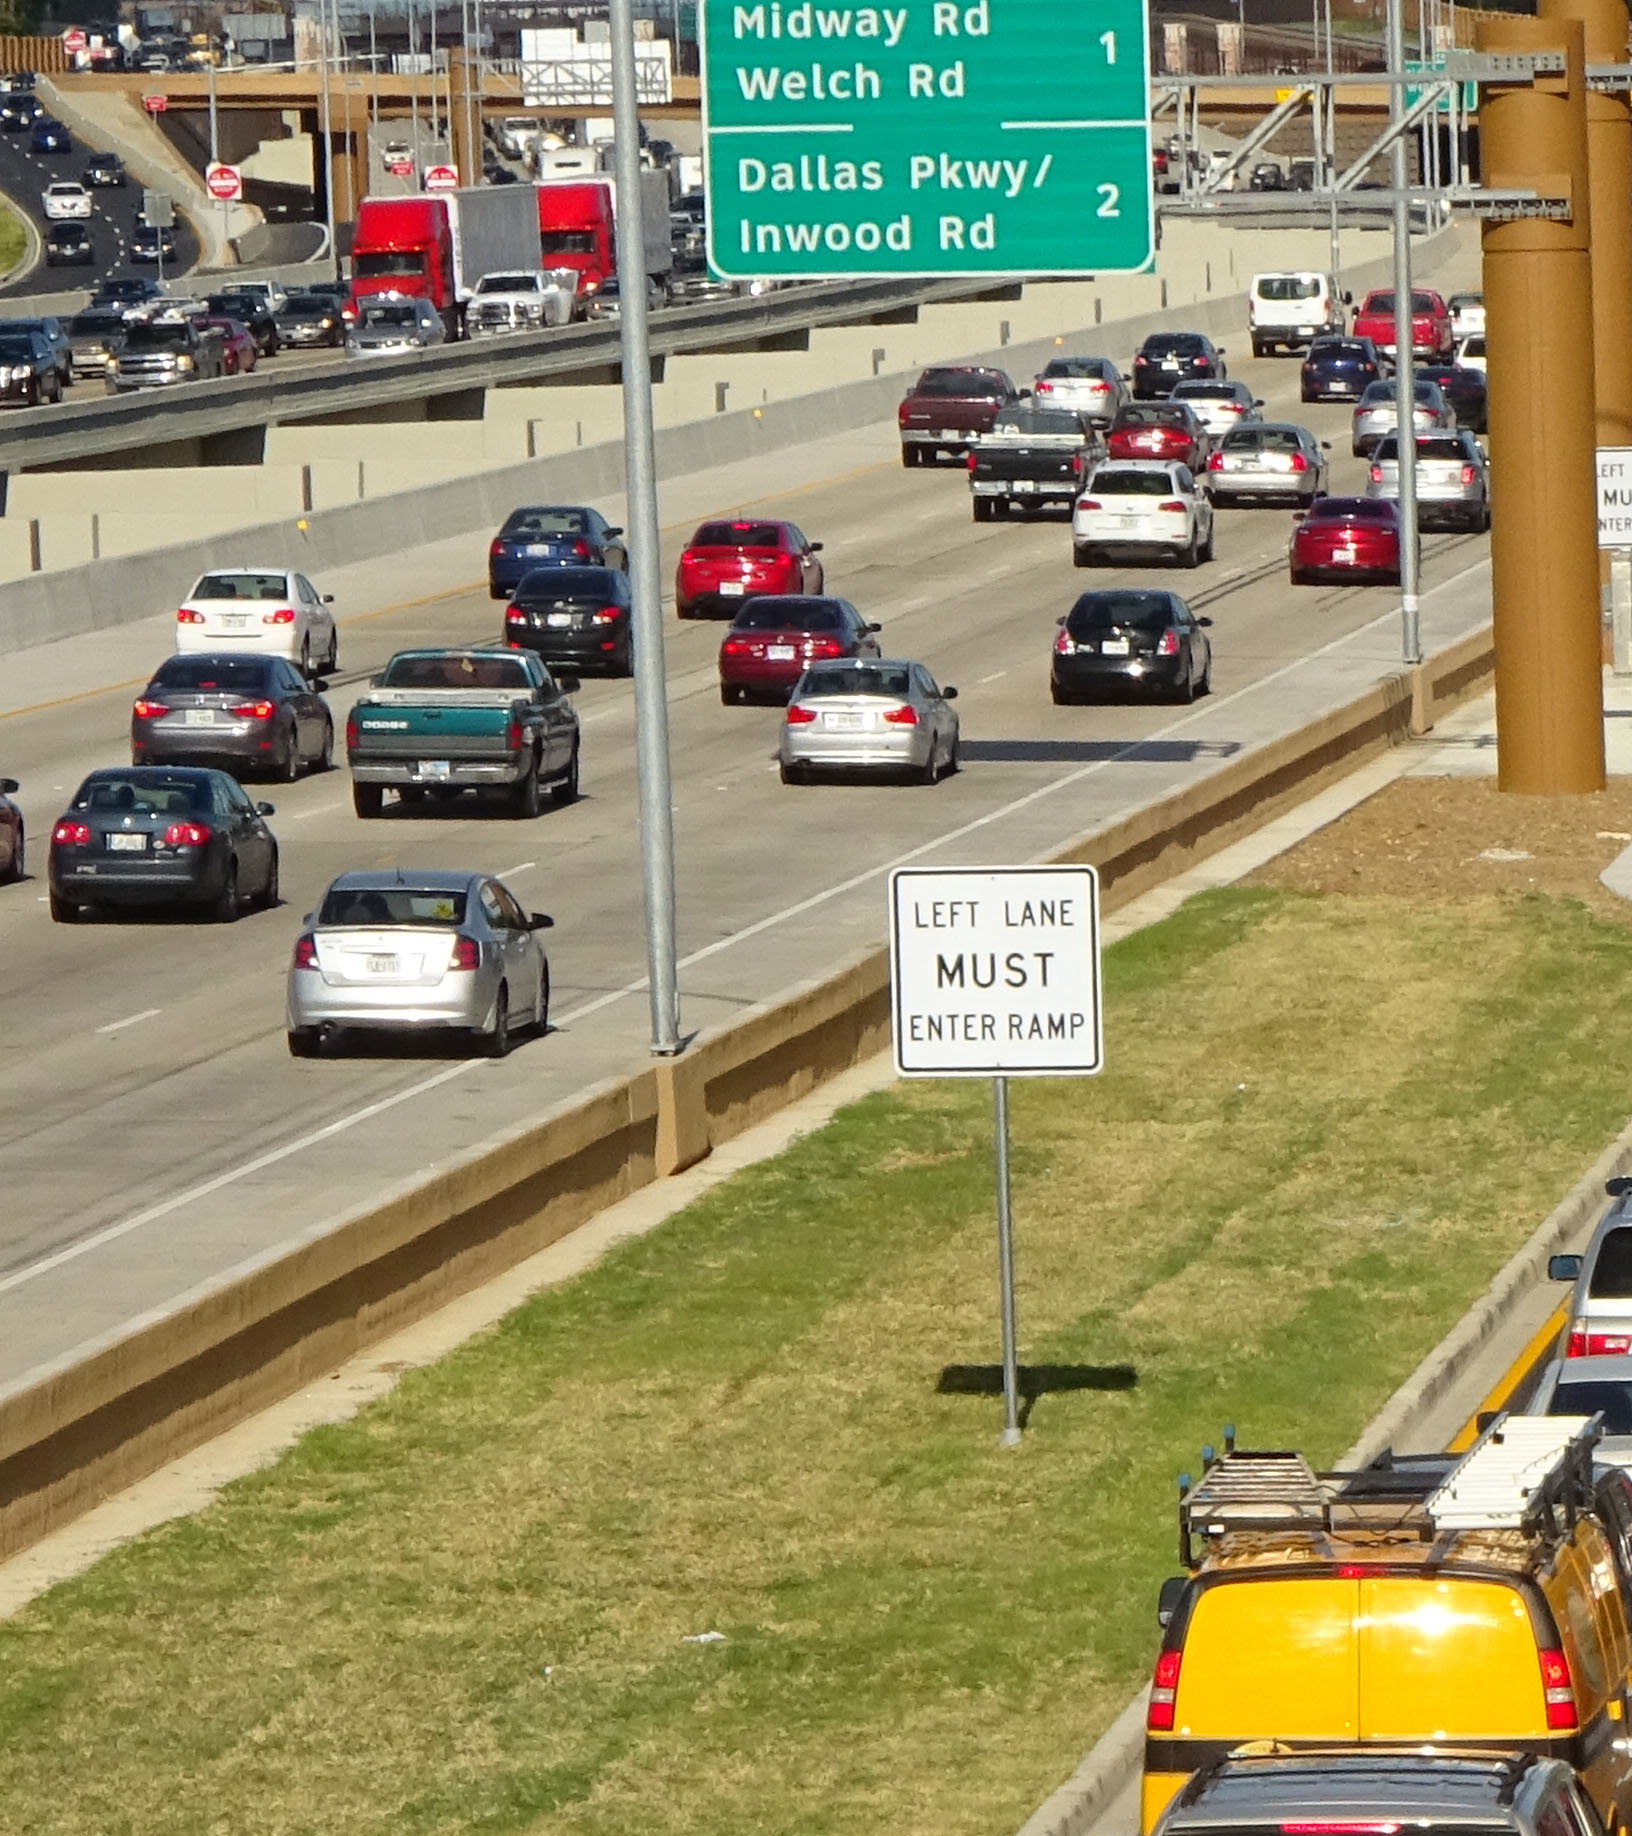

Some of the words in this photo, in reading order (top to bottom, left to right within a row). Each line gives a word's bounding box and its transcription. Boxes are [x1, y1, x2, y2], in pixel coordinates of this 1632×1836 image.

[734, 2, 907, 47] Midway
[933, 1, 989, 37] Rd
[1099, 31, 1117, 65] 1
[736, 63, 881, 100] Welch
[909, 61, 966, 98] Rd
[738, 154, 883, 192] Dallas
[1096, 183, 1120, 217] 2
[740, 215, 911, 252] Inwood
[939, 214, 997, 250] Rd
[1598, 517, 1632, 531] NTER
[915, 901, 979, 927] LEFT
[1005, 900, 1074, 926] LANE
[937, 953, 1054, 988] MUST
[910, 1014, 996, 1041] ENTER
[1009, 1013, 1085, 1040] RAMP
